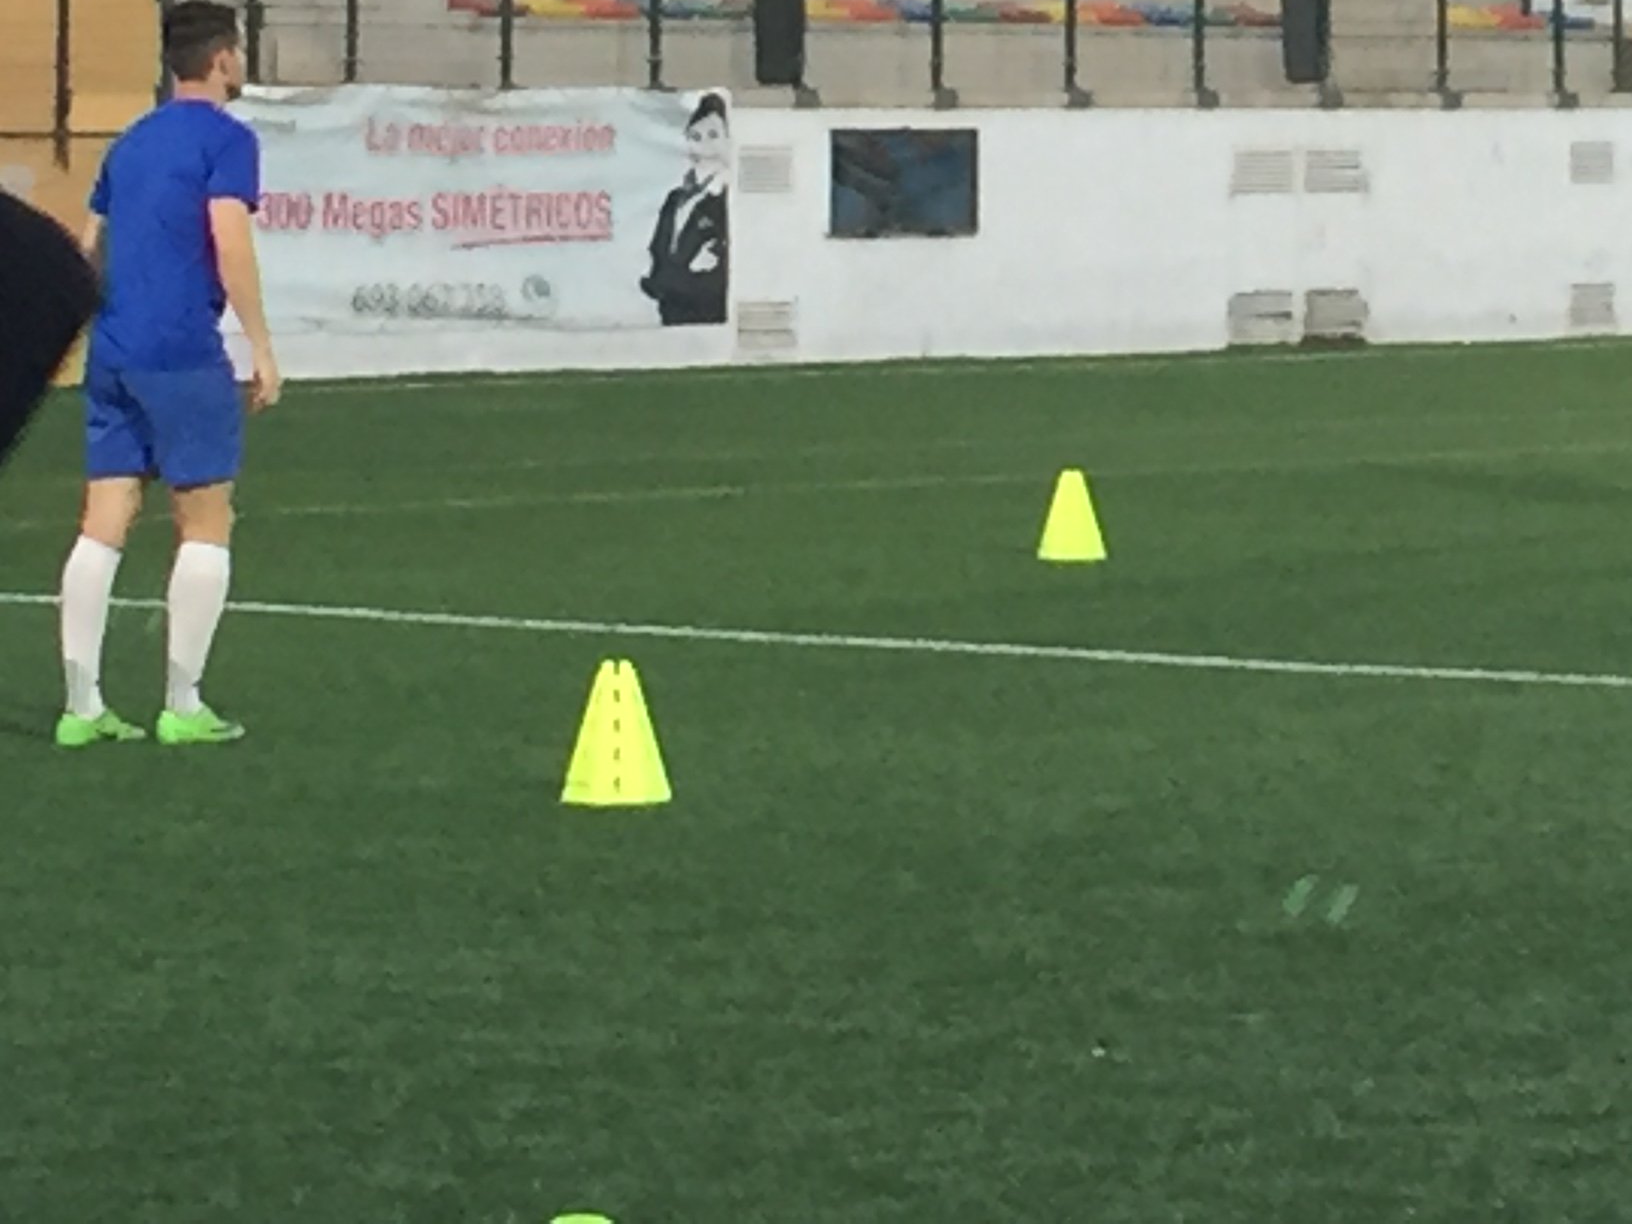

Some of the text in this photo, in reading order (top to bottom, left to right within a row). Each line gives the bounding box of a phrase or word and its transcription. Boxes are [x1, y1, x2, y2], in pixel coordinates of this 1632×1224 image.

[257, 183, 612, 243] 300 Megas SIMÉTRICOS
